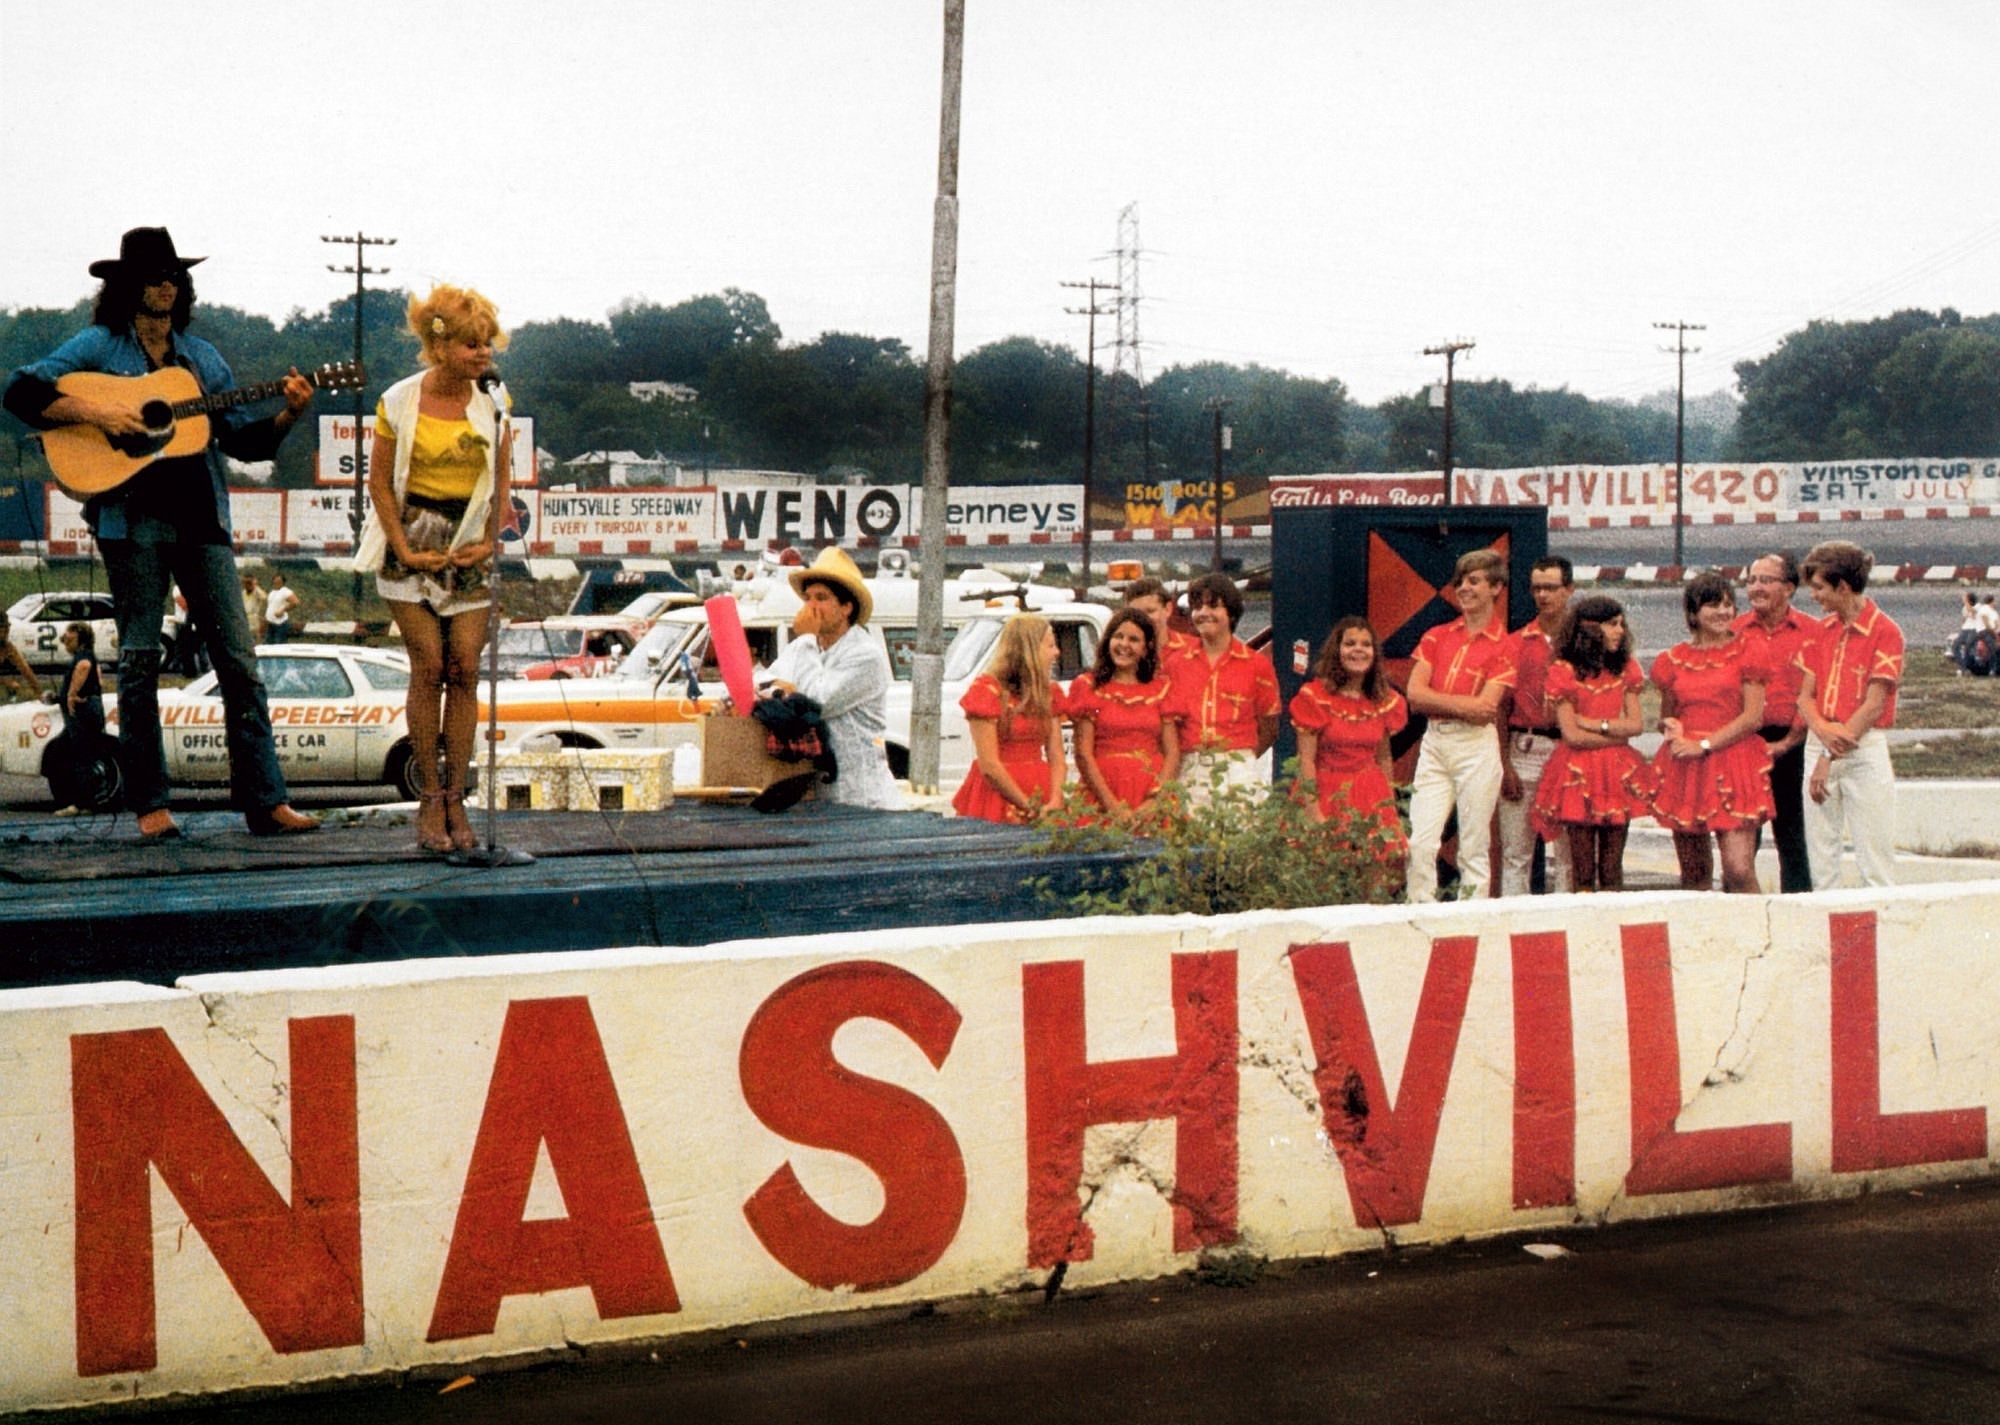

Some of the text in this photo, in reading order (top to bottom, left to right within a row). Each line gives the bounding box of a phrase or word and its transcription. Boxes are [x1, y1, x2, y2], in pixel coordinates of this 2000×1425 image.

[1926, 463, 1971, 479] CUP
[1982, 465, 2000, 479] G
[1126, 483, 1164, 501] 1510
[1456, 469, 1678, 506] NASHVILLE
[1902, 481, 1974, 500] JULY
[321, 495, 342, 510] WE
[543, 497, 703, 516] HUNTSVILLE SPEEDWAY
[722, 488, 901, 540] WENO
[947, 502, 1077, 531] enneys
[552, 521, 588, 535] EVERY
[595, 520, 649, 535] THURSDAY
[655, 520, 663, 534] 8
[37, 625, 58, 652] 2
[269, 705, 408, 725] PEEDWAY
[297, 734, 327, 748] CAR
